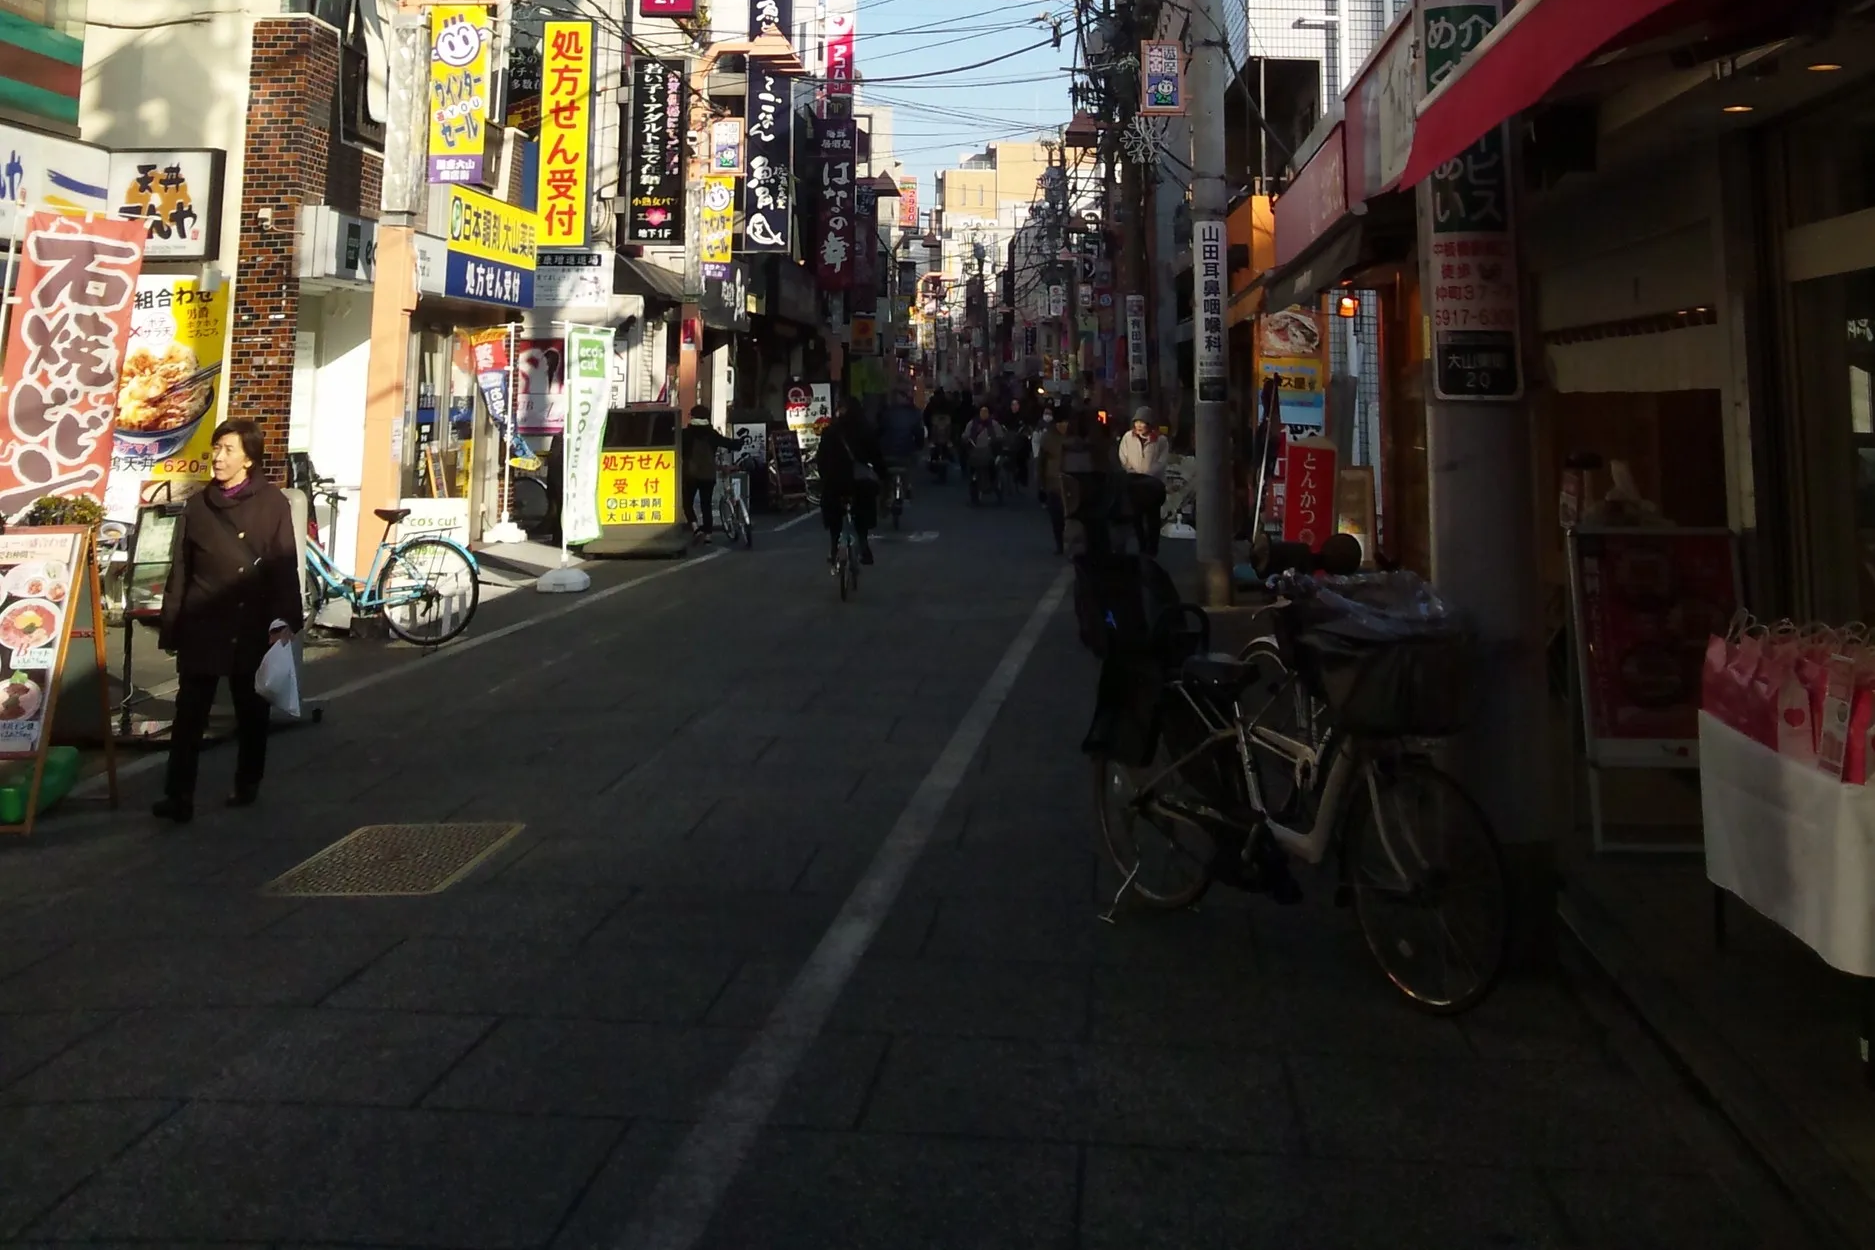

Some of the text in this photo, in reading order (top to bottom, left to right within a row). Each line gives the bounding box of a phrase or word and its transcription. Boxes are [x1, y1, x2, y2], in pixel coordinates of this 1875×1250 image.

[834, 44, 847, 80] アコム
[545, 30, 584, 237] 処方せん受付
[136, 161, 186, 194] 天丼
[462, 206, 536, 261] 日本調剤 大山薬局
[637, 228, 673, 239] 地下1F
[465, 260, 521, 304] 処方せん受付
[1202, 225, 1223, 353] 山田耳鼻咽喉科
[134, 286, 214, 311] 組合わせ
[580, 358, 598, 371] cut
[163, 459, 208, 474] 620円
[602, 453, 670, 473] 処方せん
[612, 477, 661, 496] 受付
[1299, 452, 1318, 523] とんかつ
[618, 497, 662, 509] 日本調剤
[437, 516, 457, 527] cut
[607, 510, 662, 523] 大山薬局
